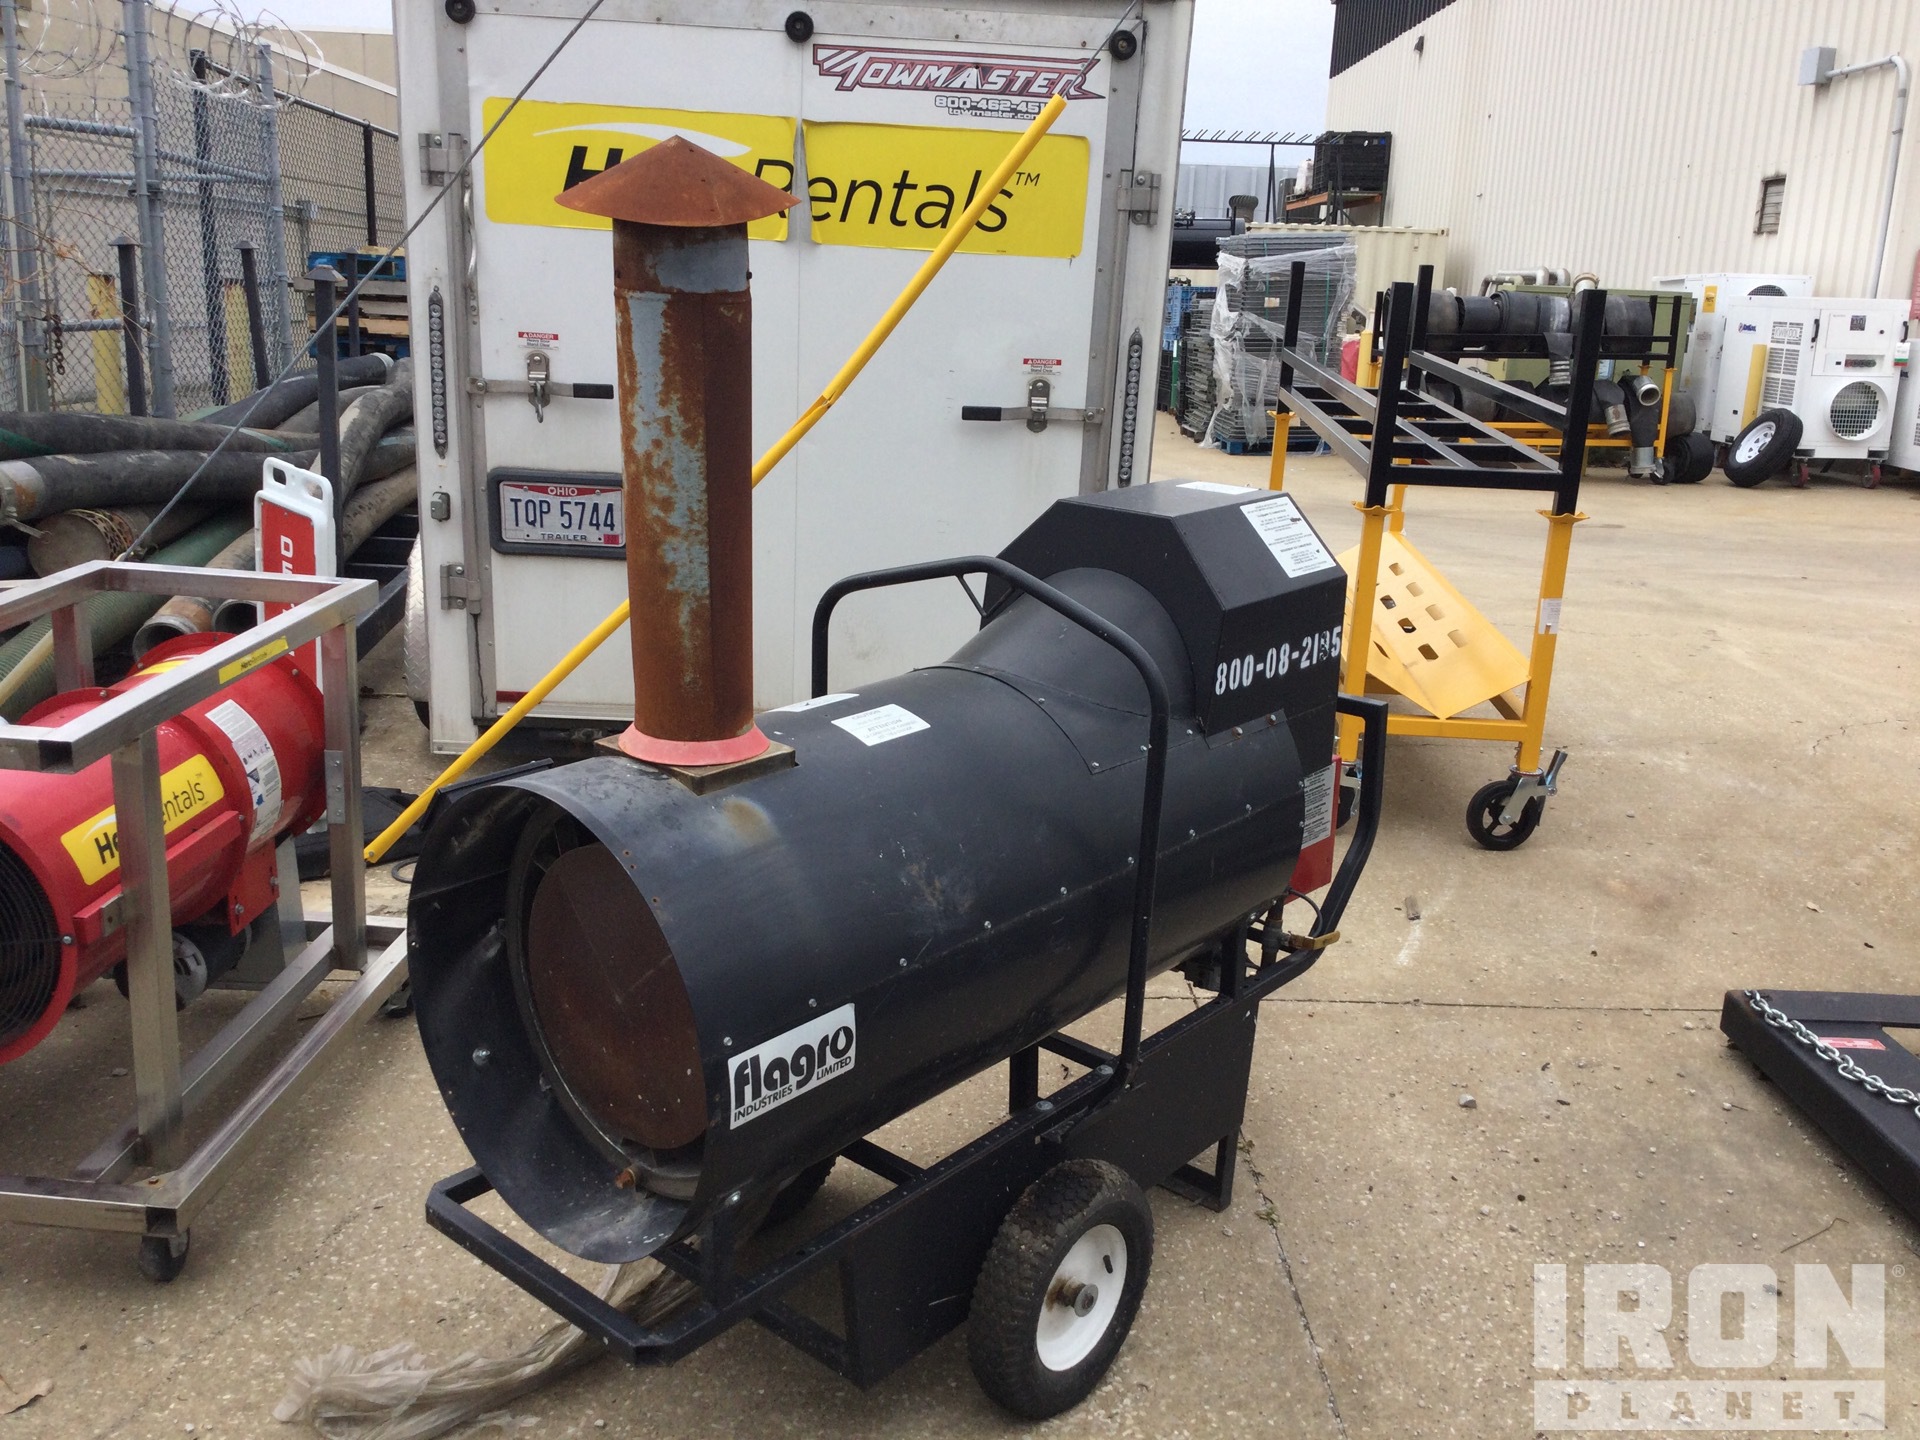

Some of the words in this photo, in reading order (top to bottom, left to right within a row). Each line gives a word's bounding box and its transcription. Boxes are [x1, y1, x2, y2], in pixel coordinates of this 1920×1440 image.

[814, 44, 1105, 99] TOWMASTER
[547, 487, 578, 497] OHIO
[510, 498, 551, 528] TQP
[560, 501, 616, 532] 5744
[541, 533, 588, 541] TRAILER
[733, 1025, 854, 1110] flagro
[733, 1084, 793, 1122] INDUSTRIES
[816, 1055, 852, 1081] LIMITED
